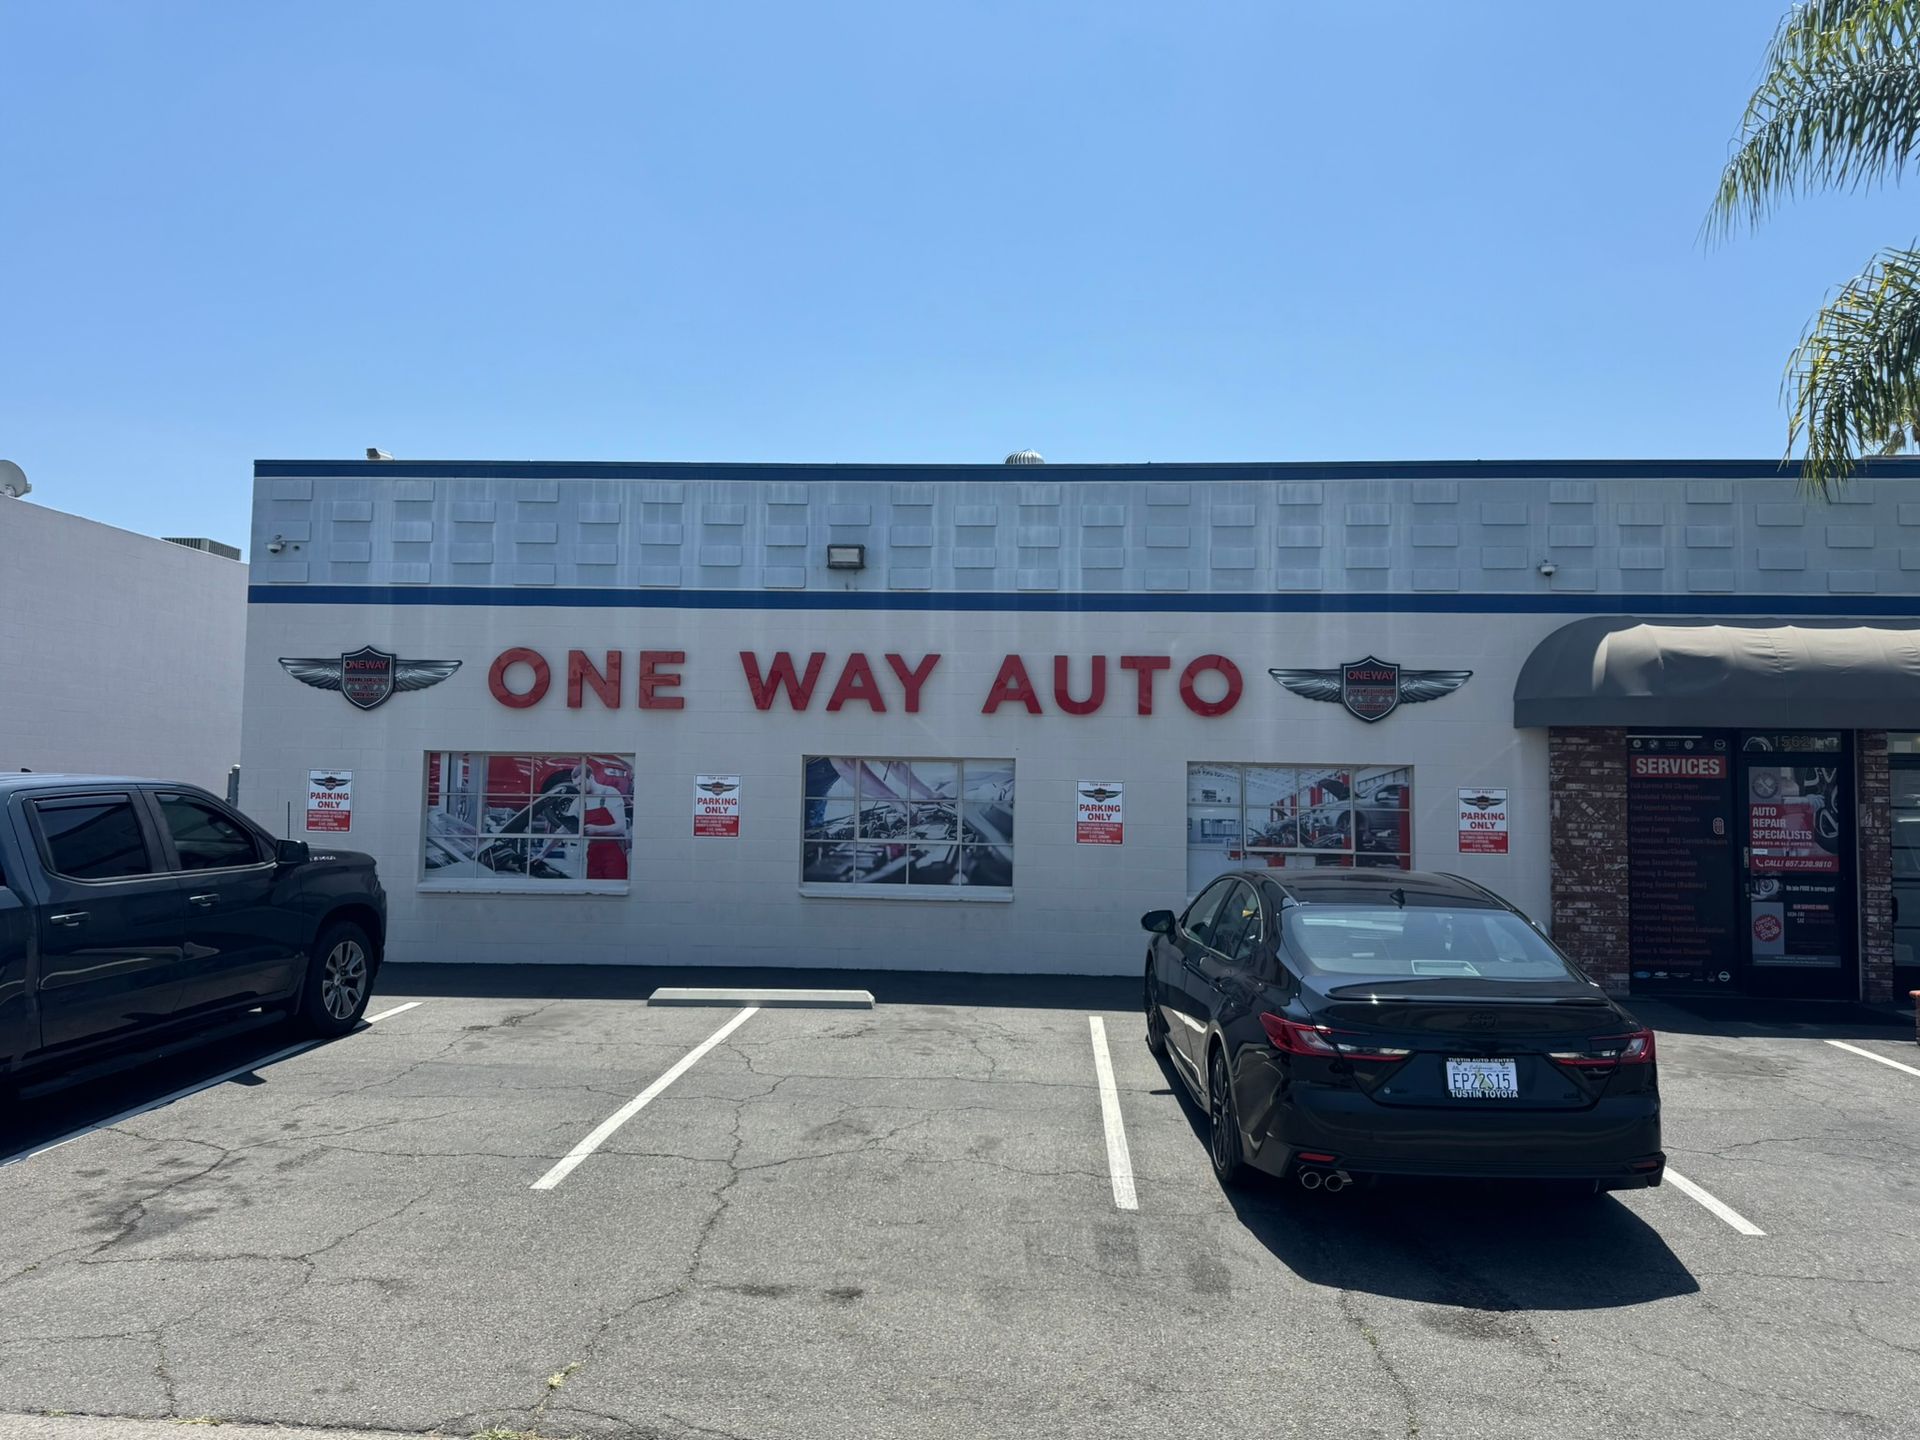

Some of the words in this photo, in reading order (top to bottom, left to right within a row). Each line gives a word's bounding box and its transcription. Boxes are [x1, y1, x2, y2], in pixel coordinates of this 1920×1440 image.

[1347, 671, 1396, 681] ONEWAY
[489, 647, 685, 709] ONE
[740, 652, 940, 714] WAY
[982, 654, 1243, 717] AUTO
[1636, 758, 1720, 775] SERVICES
[310, 792, 350, 801] PARKING
[317, 801, 341, 809] ONLY
[697, 797, 738, 806] PARKING
[705, 806, 729, 814] ONLY
[1080, 804, 1121, 812] PARKING
[1752, 807, 1777, 816] AUTO
[1088, 813, 1112, 821] ONLY
[1461, 812, 1506, 821] PARKING
[1470, 821, 1496, 830] ONLY
[1752, 818, 1786, 828] REPAIR
[1752, 830, 1813, 840] SPECIALISTS
[1453, 1073, 1511, 1090] EP22S15
[1451, 1090, 1482, 1098] TUSTIN
[1485, 1090, 1519, 1098] TOYOTA
